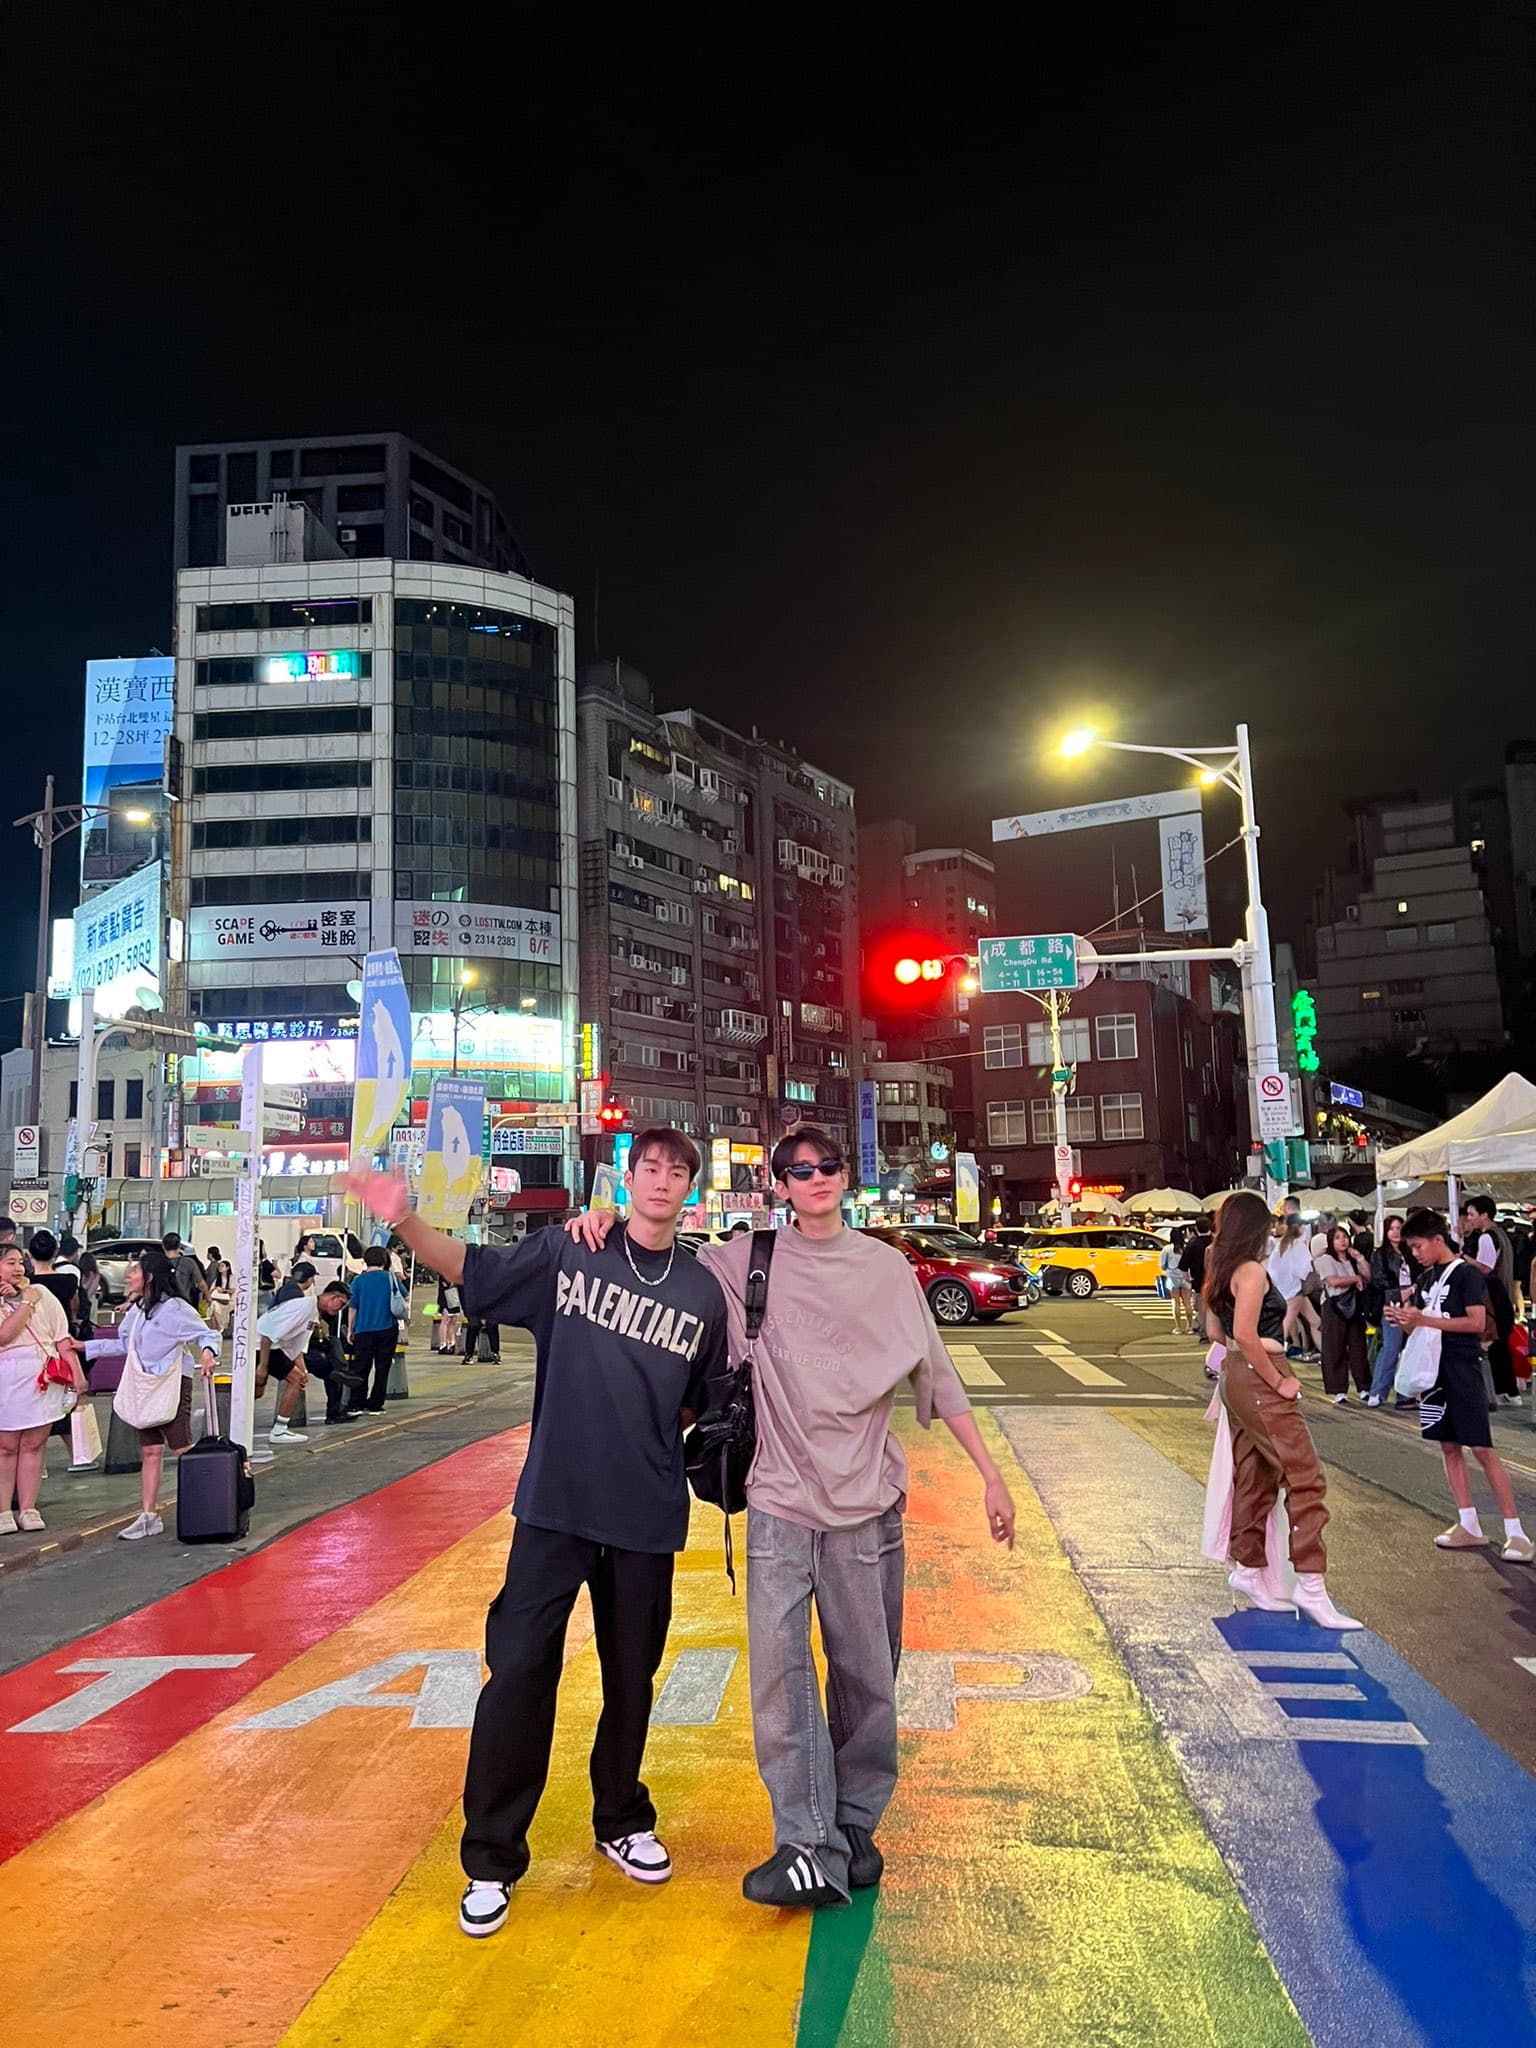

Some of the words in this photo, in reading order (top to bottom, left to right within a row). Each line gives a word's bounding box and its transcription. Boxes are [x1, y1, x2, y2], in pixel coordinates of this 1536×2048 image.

[208, 917, 255, 931] ESCAPE
[321, 911, 356, 927] 密室
[474, 916, 522, 930] LOSTTW.COM
[525, 919, 552, 937] 本棟
[217, 932, 255, 945] GAME
[321, 930, 356, 946] 逃脫
[475, 934, 495, 945] 2314
[990, 938, 1065, 958] 成都路
[1003, 958, 1038, 968] ChengDu
